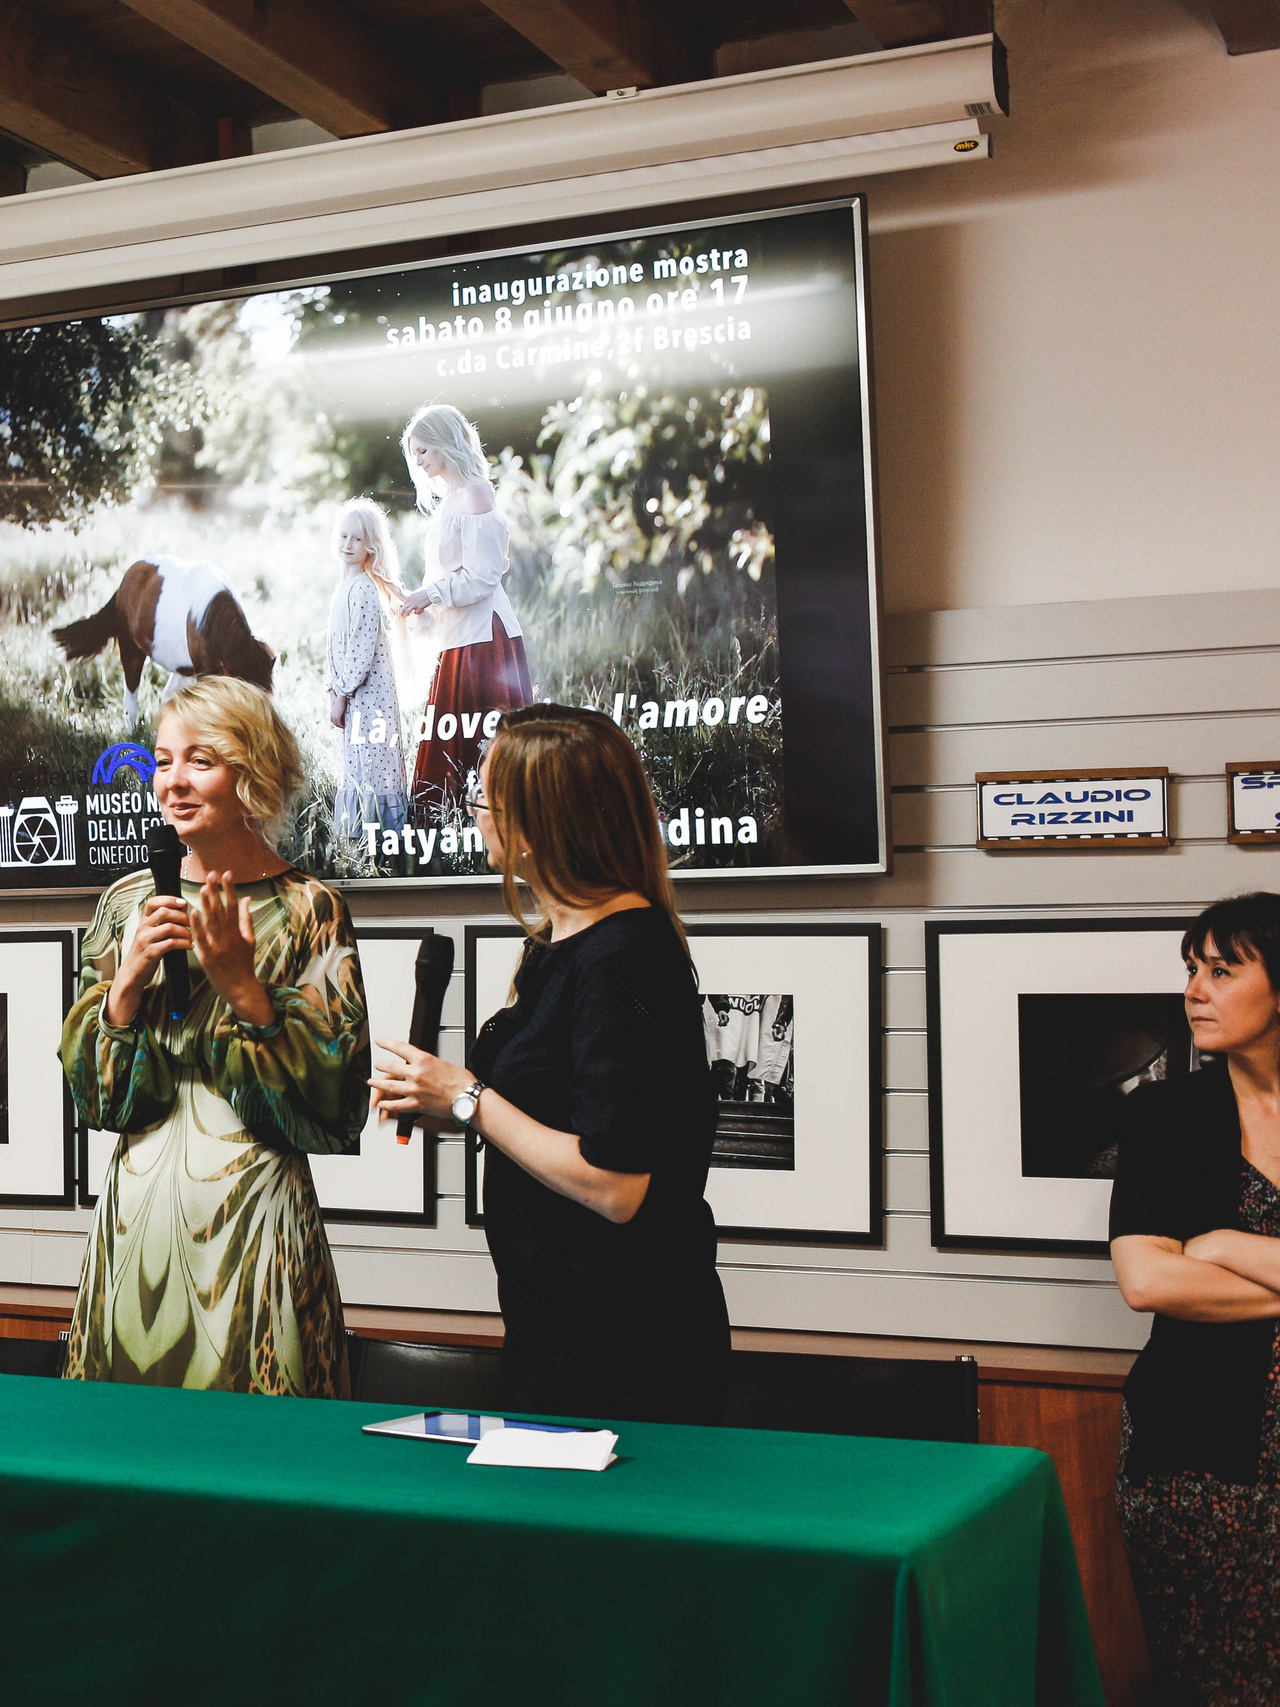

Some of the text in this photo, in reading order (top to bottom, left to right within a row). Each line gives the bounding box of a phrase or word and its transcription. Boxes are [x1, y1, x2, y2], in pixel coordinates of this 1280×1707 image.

[452, 248, 749, 307] inaugurazione mostra
[386, 274, 749, 349] sabato 8 giugno ore 17
[436, 349, 487, 377] c.da
[653, 315, 752, 351] Brescia
[350, 692, 769, 748] Là, dove l'amore
[86, 792, 142, 815] MUSEO
[993, 788, 1151, 806] CLAUDIO
[1011, 810, 1134, 826] RIZZINI
[87, 819, 138, 841] DELLA
[361, 807, 758, 866] Tatyan dina
